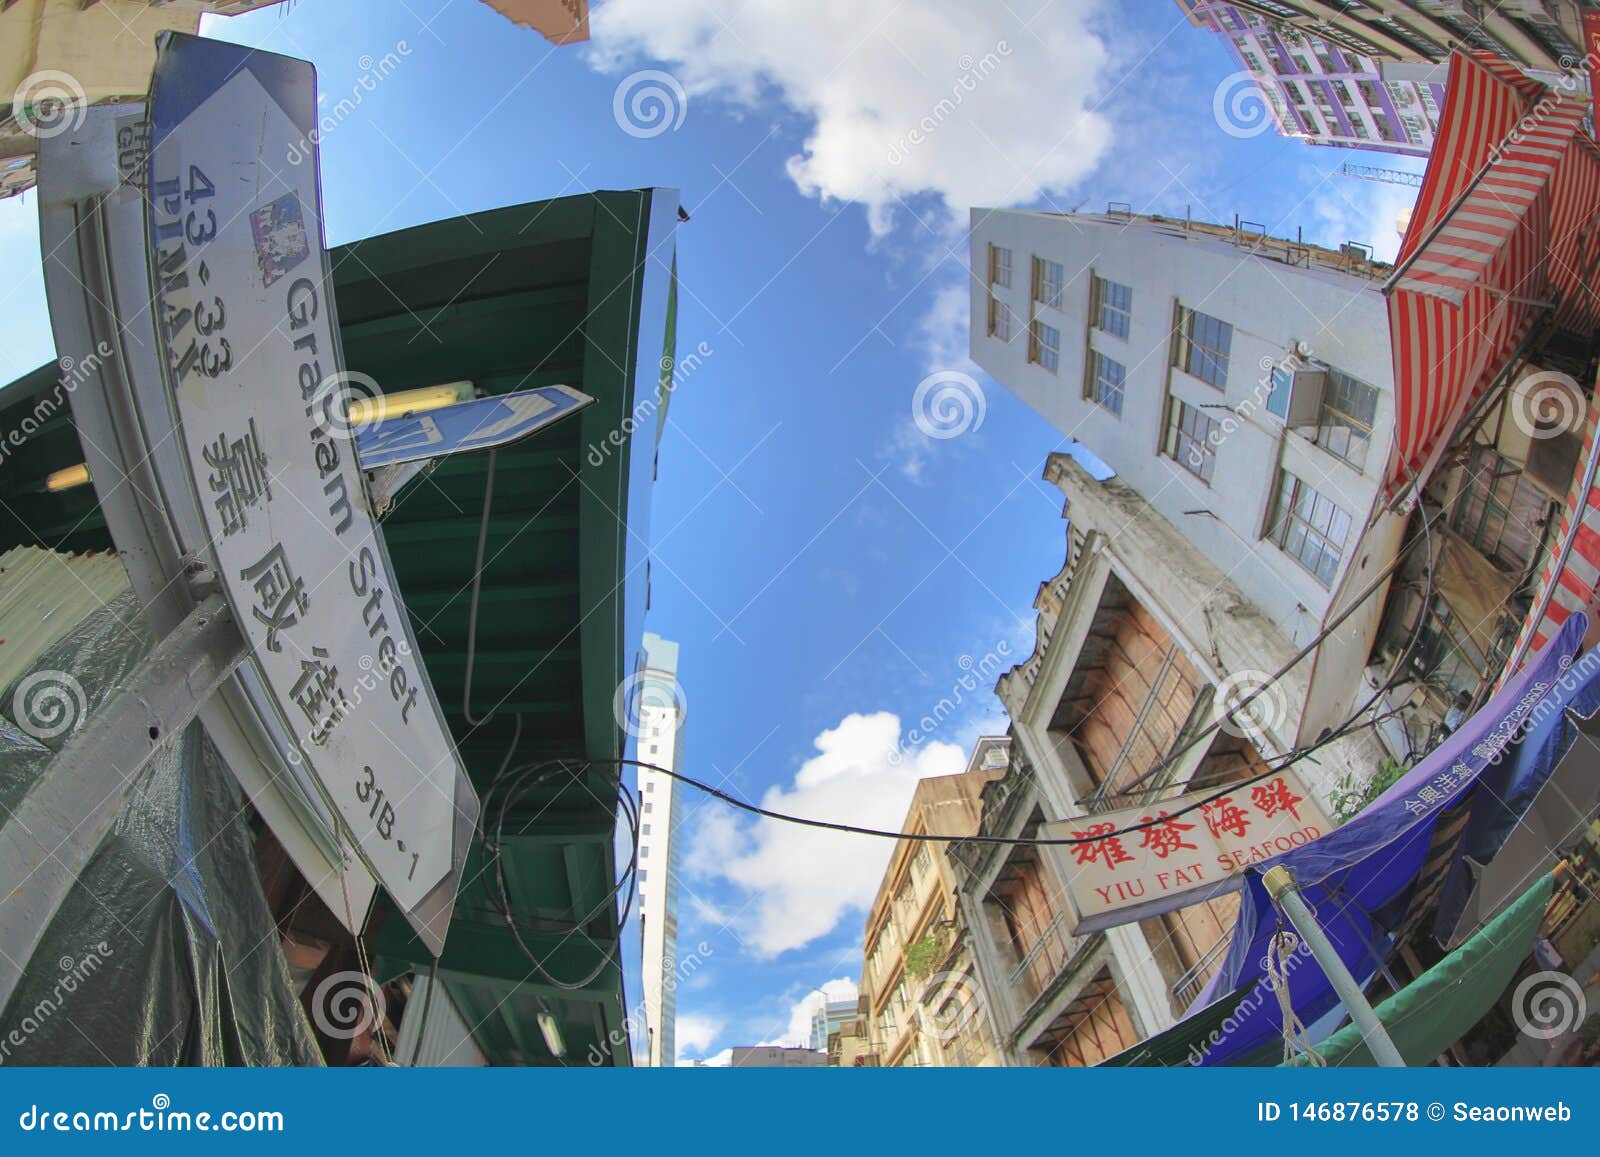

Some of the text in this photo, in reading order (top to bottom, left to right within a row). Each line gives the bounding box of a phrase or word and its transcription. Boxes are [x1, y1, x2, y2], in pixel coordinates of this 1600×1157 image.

[202, 416, 346, 746] 嘉咸街
[287, 277, 418, 725] Graham Street
[1069, 777, 1303, 871] 耀發海鮮
[1095, 825, 1321, 905] YIU FAT SEAFOOD
